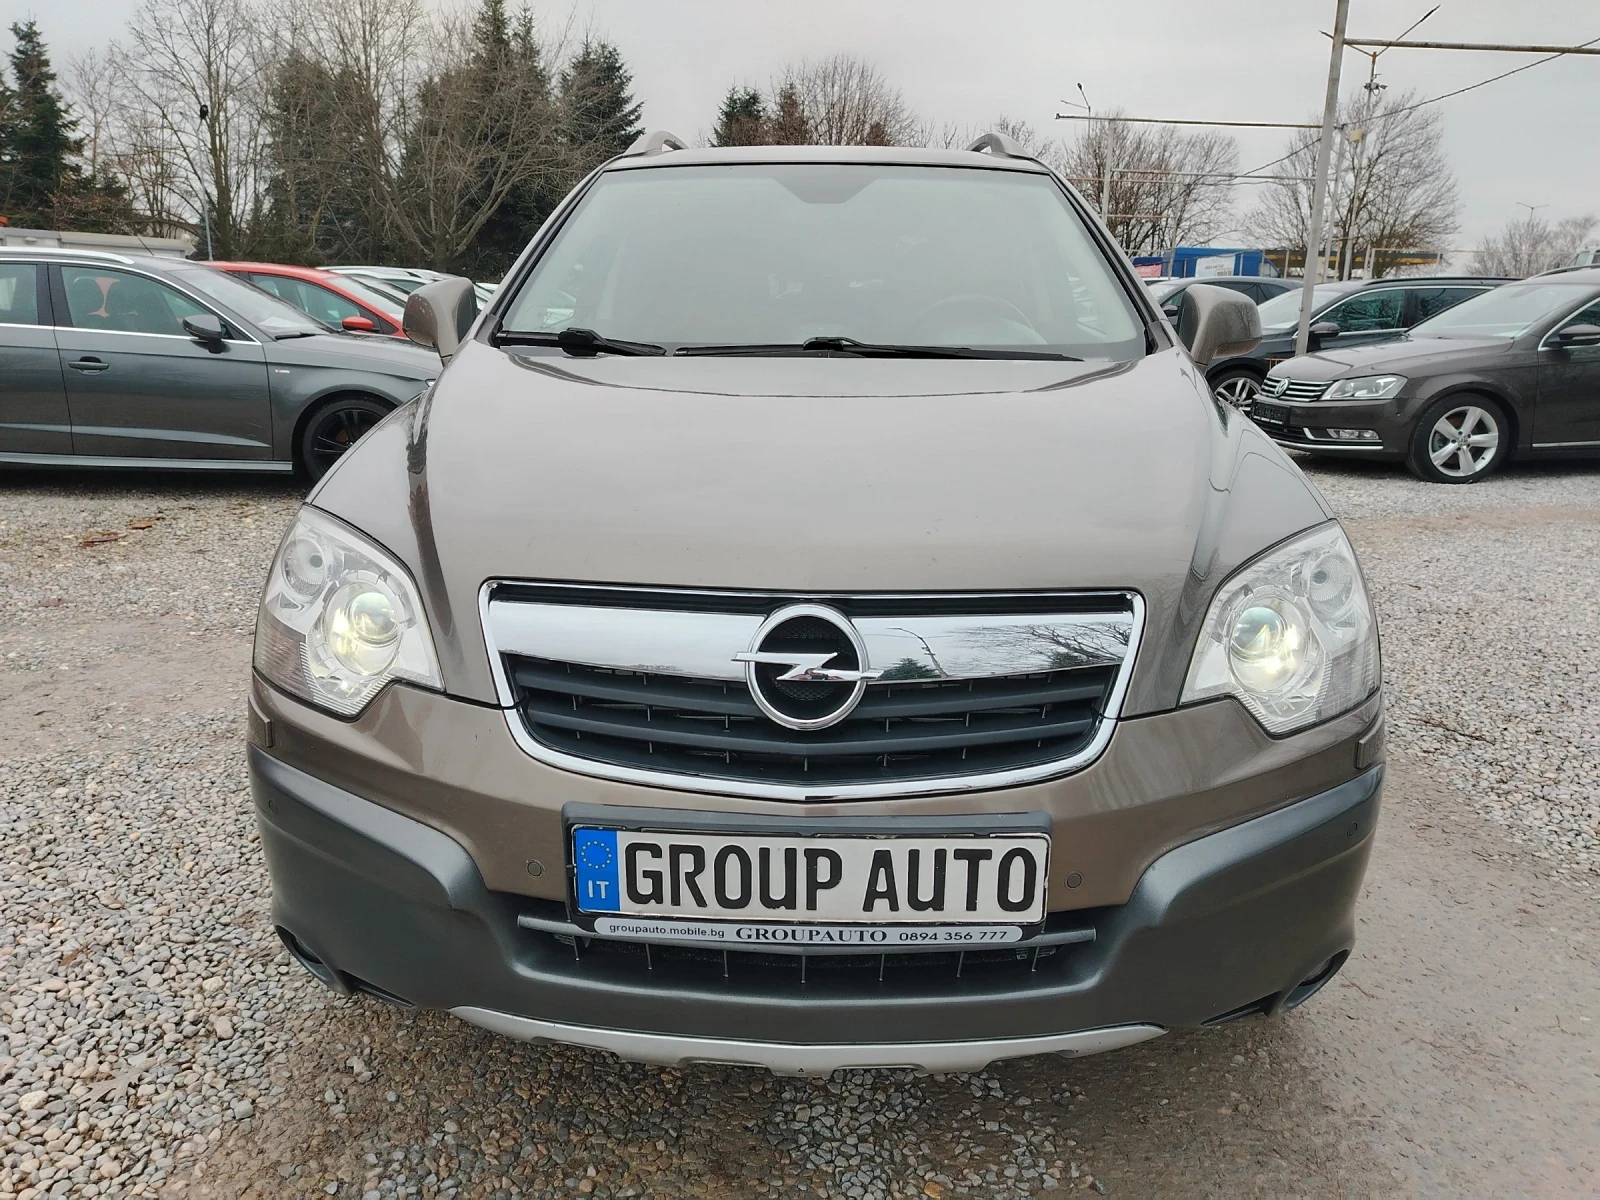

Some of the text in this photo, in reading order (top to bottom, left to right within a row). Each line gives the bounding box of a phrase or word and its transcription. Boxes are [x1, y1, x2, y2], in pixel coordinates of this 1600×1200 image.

[625, 842, 1037, 912] GROUP AUTO
[588, 880, 609, 899] IT
[609, 923, 1008, 942] groupauto.mobile.bg GROUPAUTO 0894 356 777
